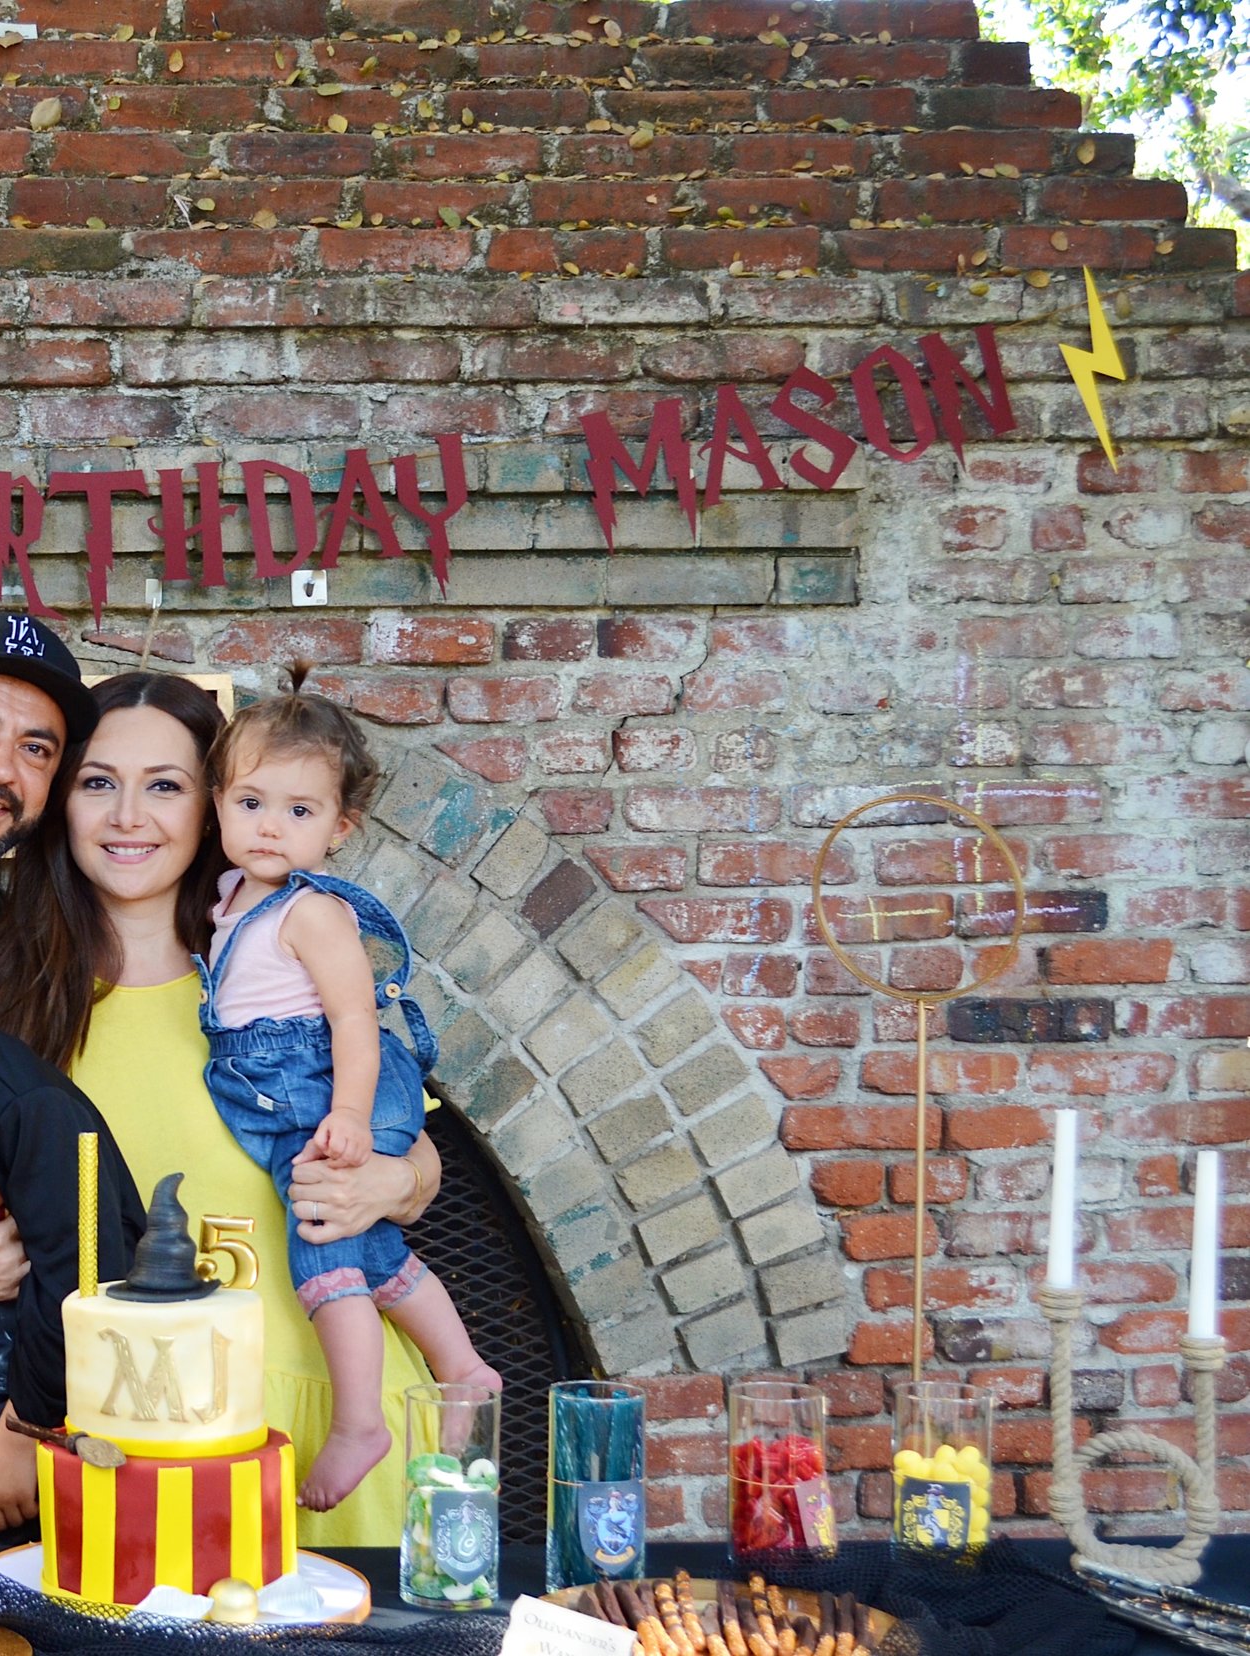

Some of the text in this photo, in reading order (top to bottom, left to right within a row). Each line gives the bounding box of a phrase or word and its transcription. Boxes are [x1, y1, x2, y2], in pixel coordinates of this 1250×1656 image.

[579, 324, 1016, 553] MASON
[4, 615, 45, 657] LA
[194, 1213, 259, 1290] 5
